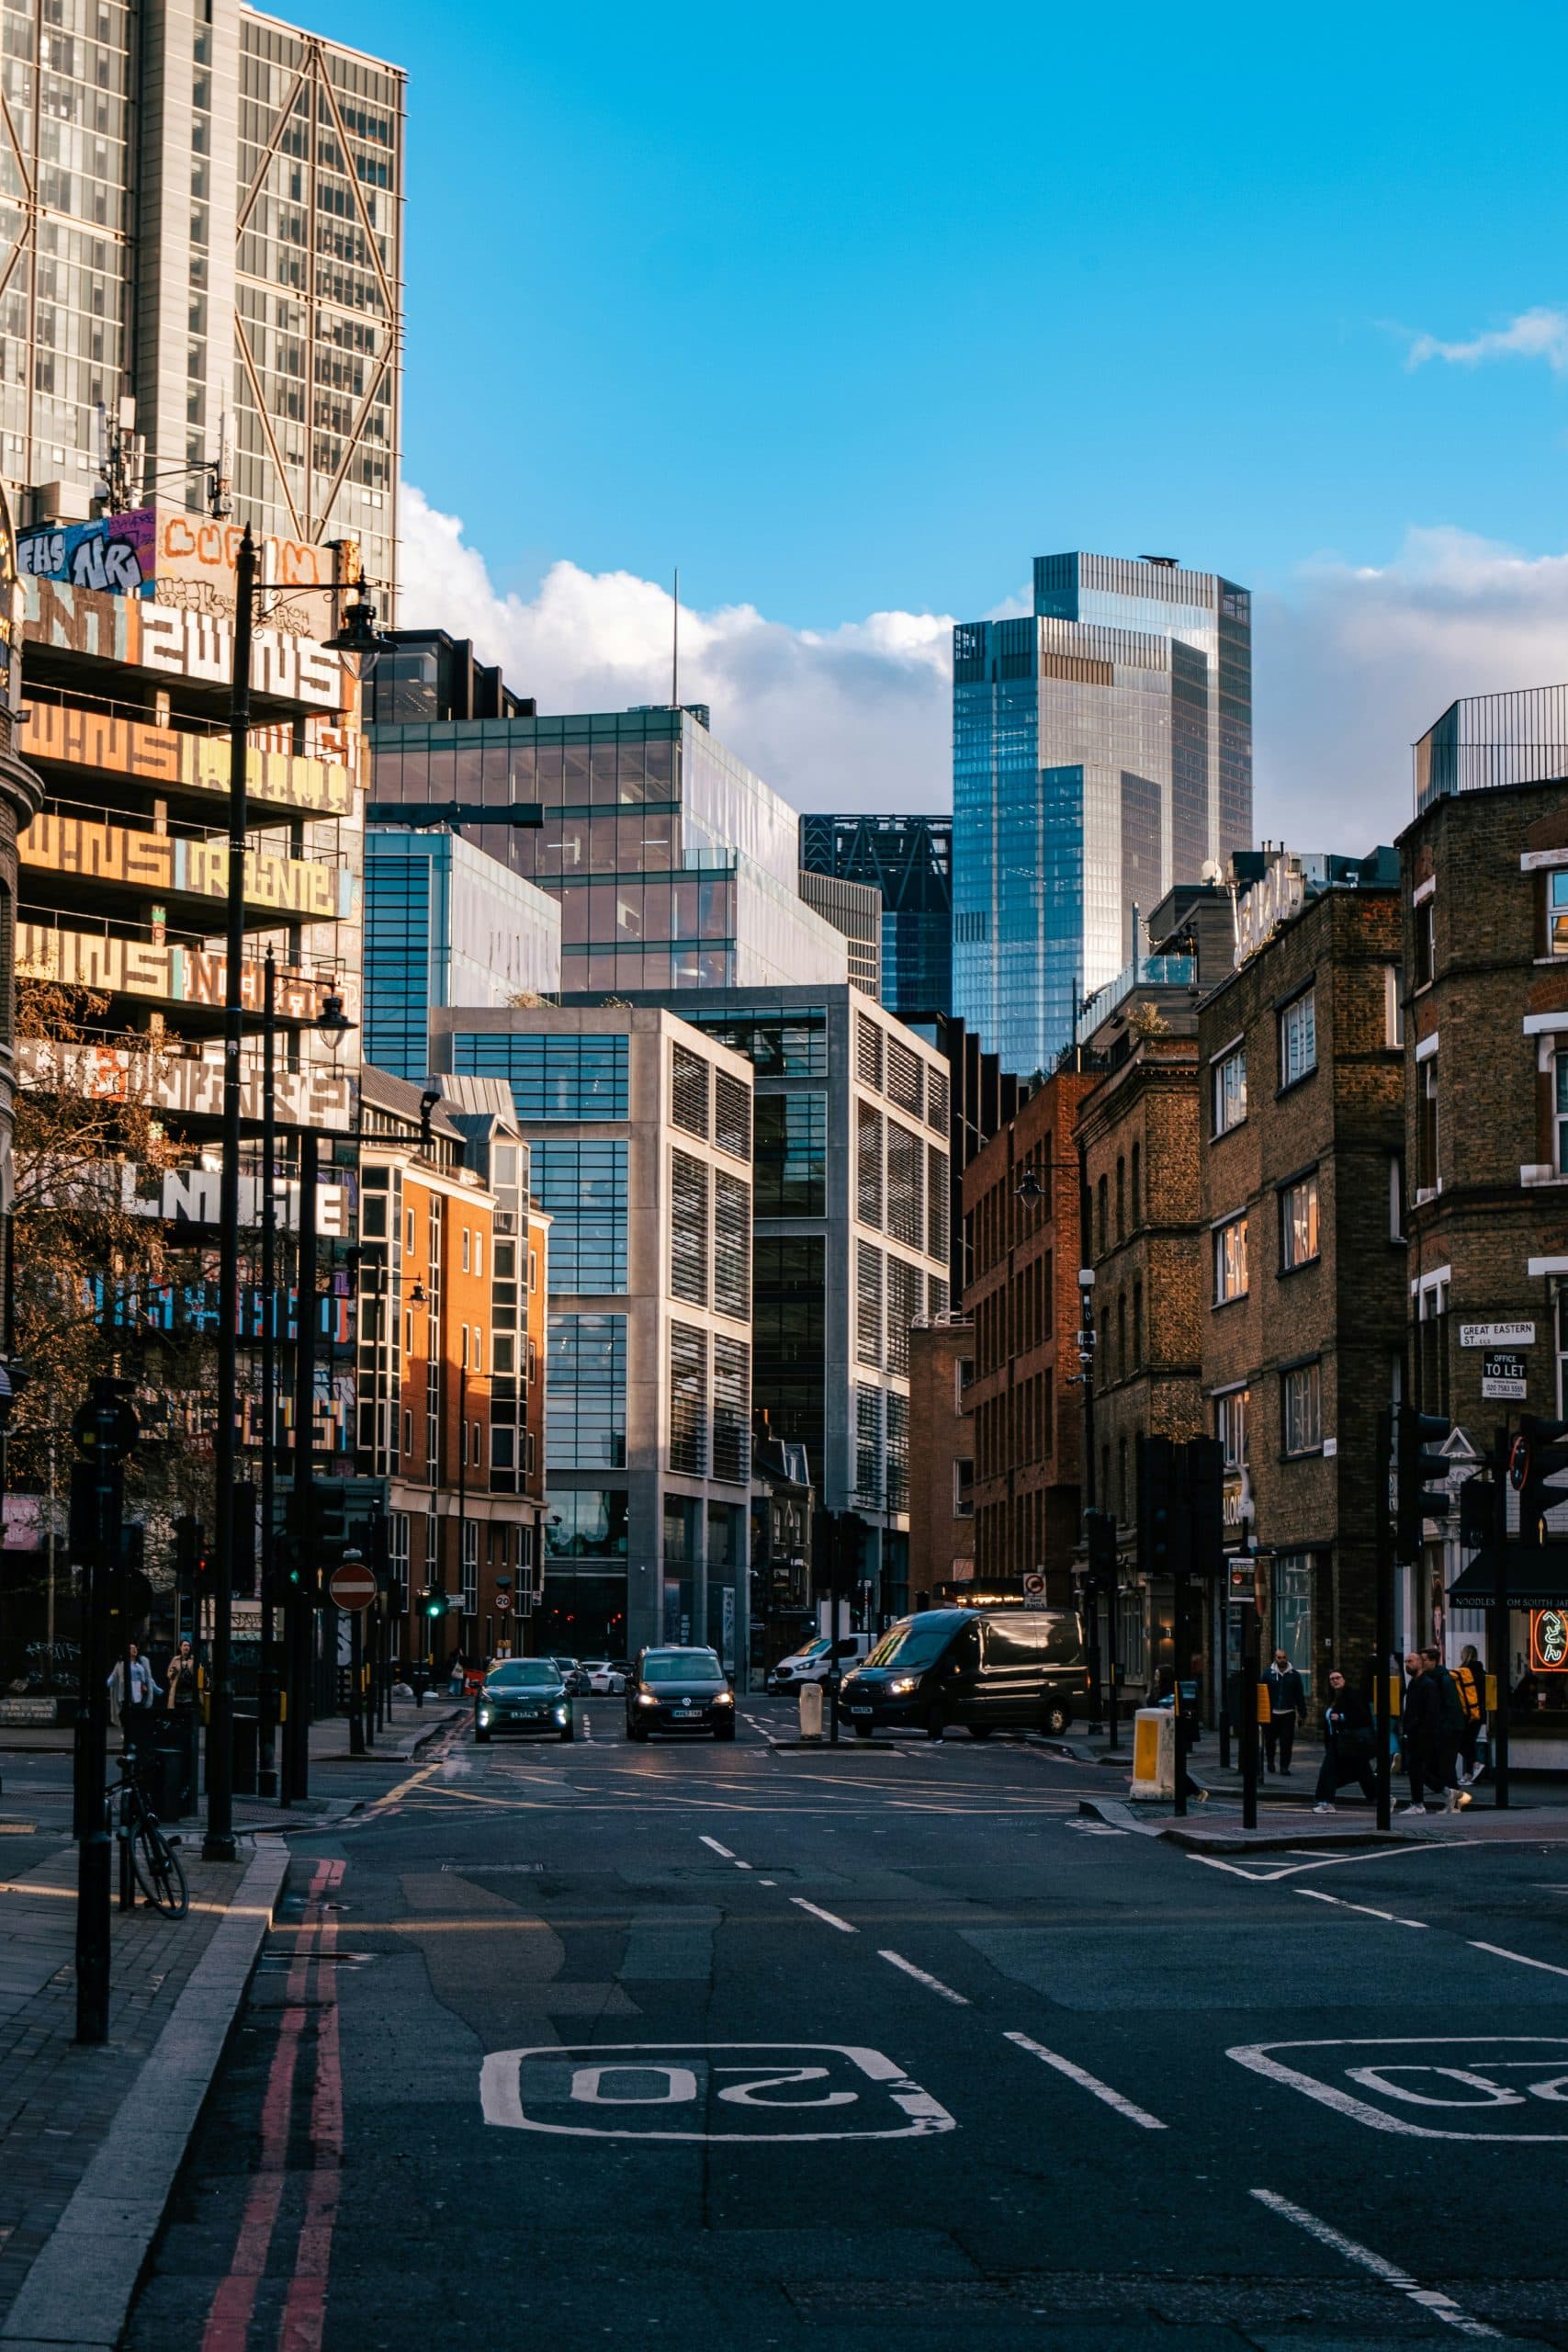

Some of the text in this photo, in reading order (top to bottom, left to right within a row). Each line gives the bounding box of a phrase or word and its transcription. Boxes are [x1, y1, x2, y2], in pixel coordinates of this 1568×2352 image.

[1463, 1324, 1532, 1335] GREAT EASTERN
[1485, 1363, 1525, 1376] TO LET
[1455, 1598, 1495, 1606] NOODLES
[1523, 1598, 1552, 1607] SOUTH
[571, 2066, 859, 2107] 20
